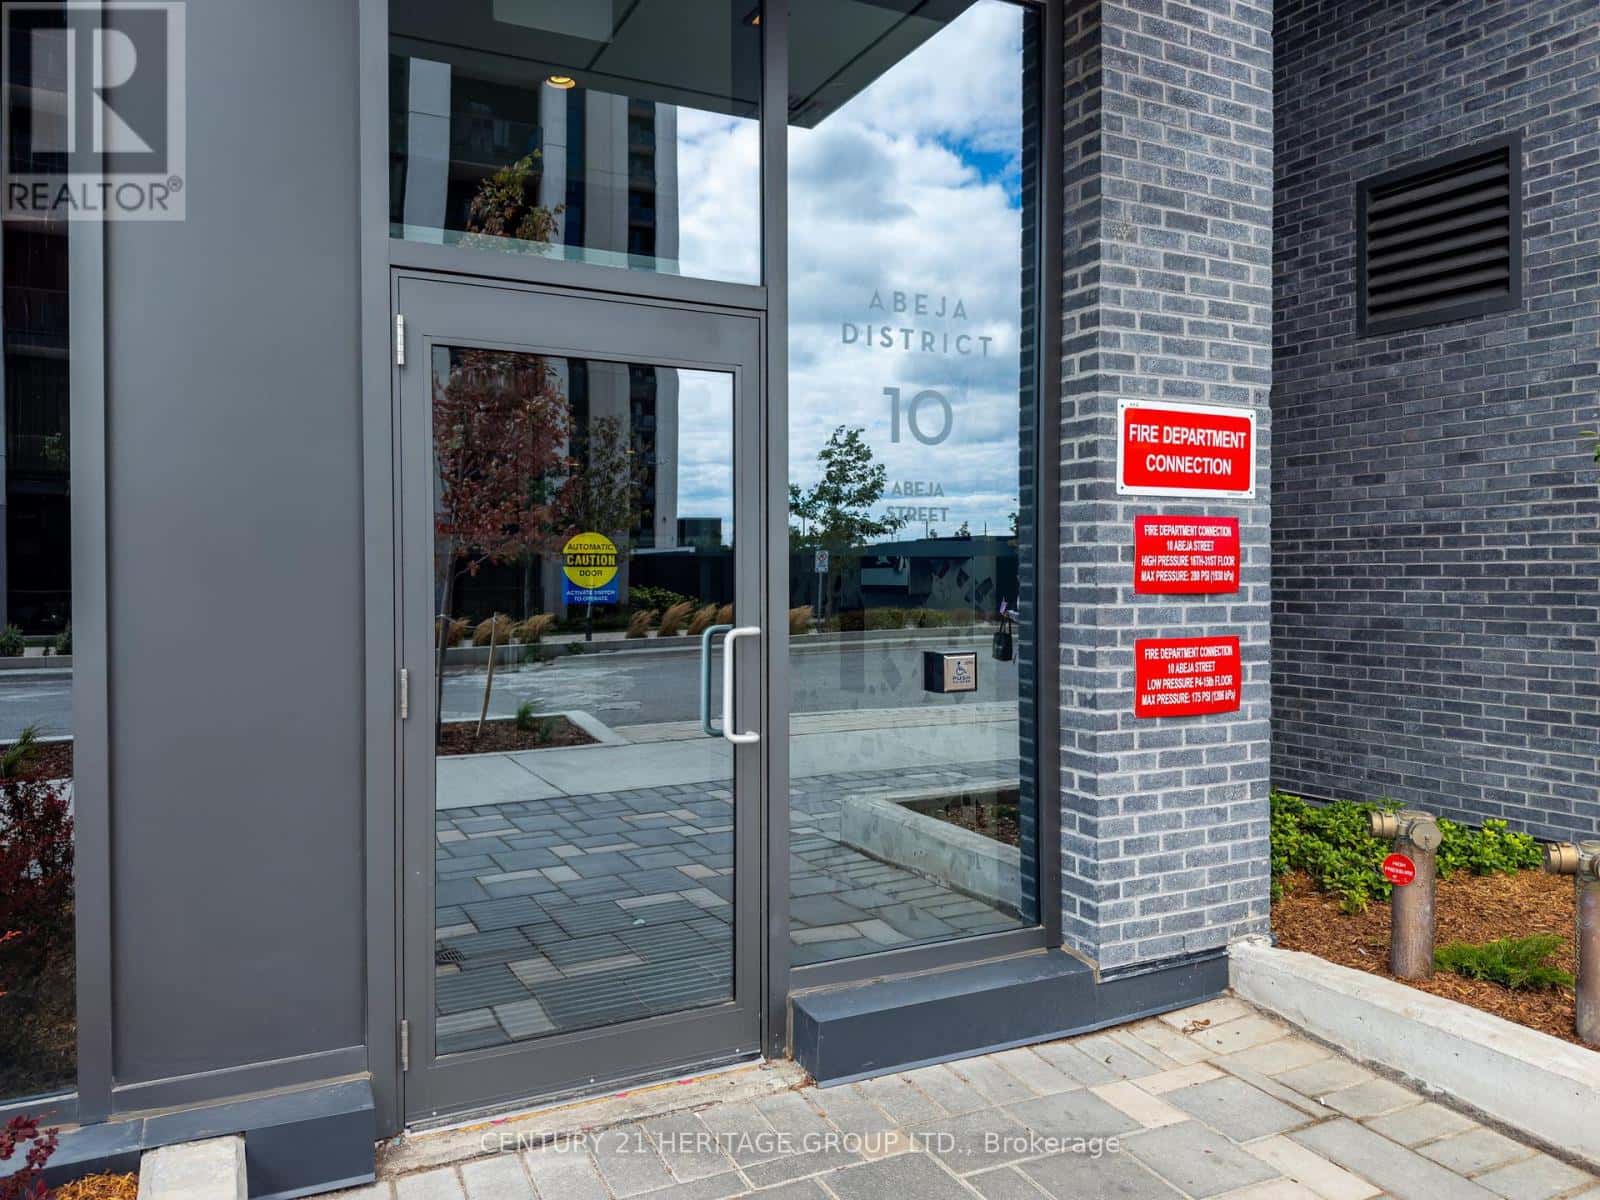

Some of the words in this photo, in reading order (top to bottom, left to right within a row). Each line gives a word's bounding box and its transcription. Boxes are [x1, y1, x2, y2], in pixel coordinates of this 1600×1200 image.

[869, 288, 967, 320] ABEJA
[841, 322, 993, 357] DISTRICT
[883, 386, 953, 446] 10
[1128, 423, 1159, 444] FIRE
[1162, 425, 1247, 449] DEPARTMENT
[1145, 453, 1232, 476] CONNECTION
[891, 481, 945, 497] ABEJA
[886, 505, 949, 522] STREET
[1144, 525, 1159, 536] FIRE
[1159, 525, 1197, 537] DEPARTMENT
[1198, 525, 1232, 537] CONNECTION
[1174, 540, 1193, 552] ABEJA
[1193, 540, 1215, 552] STREET
[566, 554, 616, 566] CAUTION
[1141, 555, 1157, 567] HIGH
[1217, 555, 1236, 567] FLOOR
[1141, 570, 1155, 582] MAX
[1144, 648, 1160, 660] FIRE
[1160, 646, 1199, 659] DEPARTMENT
[1199, 645, 1233, 657] CONNECTION
[1168, 663, 1175, 675] 10
[1175, 662, 1195, 674] ABEJA
[1195, 661, 1216, 673] STREET
[1147, 679, 1163, 691] LOW
[1162, 676, 1195, 690] PRESSURE
[1214, 674, 1233, 687] FLOOR
[1141, 694, 1156, 706] MAX
[1156, 692, 1191, 705] PRESSURE:
